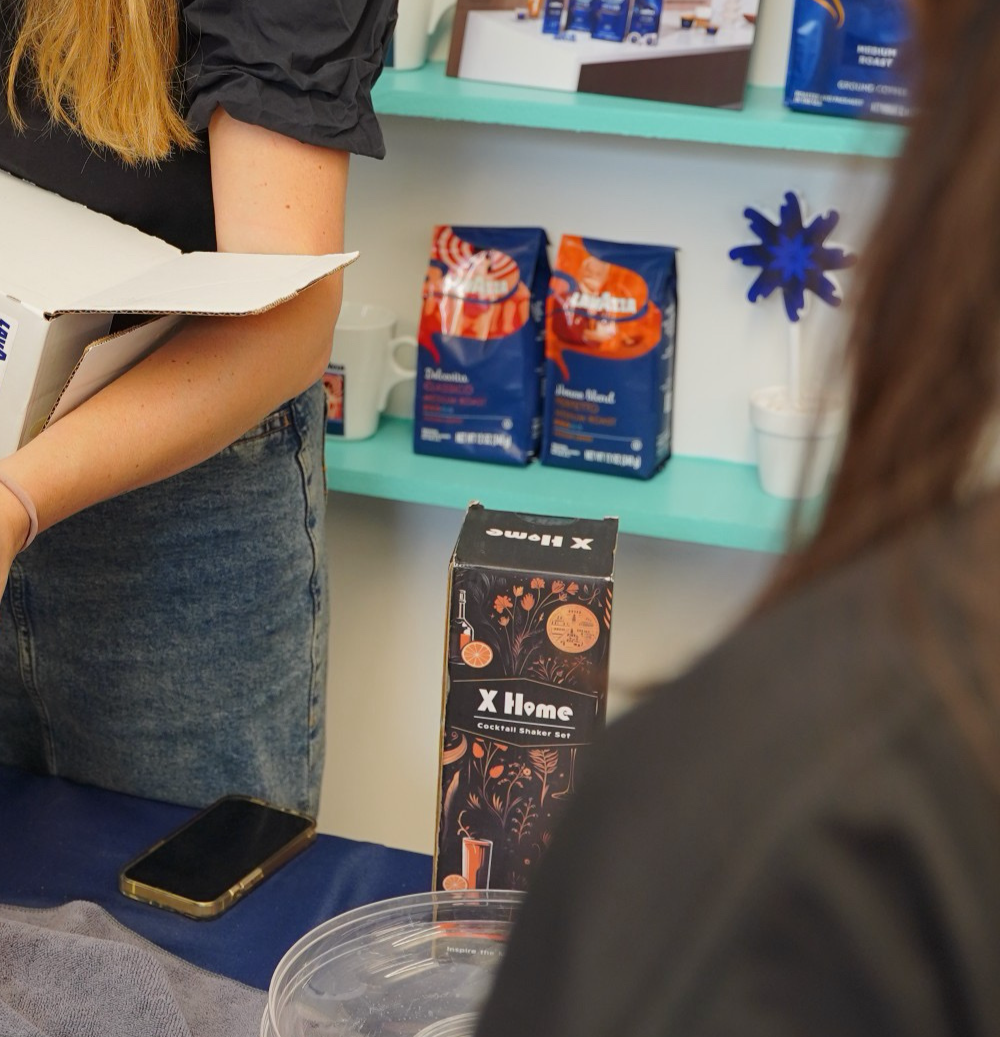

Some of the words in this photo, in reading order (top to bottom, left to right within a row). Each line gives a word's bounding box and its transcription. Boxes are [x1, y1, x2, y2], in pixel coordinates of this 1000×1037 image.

[485, 527, 564, 548] Home
[570, 537, 594, 551] X
[477, 688, 498, 714] X
[504, 691, 574, 722] Home
[477, 722, 516, 735] Cocktail
[519, 727, 552, 738] Shaker
[554, 730, 571, 739] Set
[446, 946, 477, 956] Inspire
[480, 948, 495, 957] the
